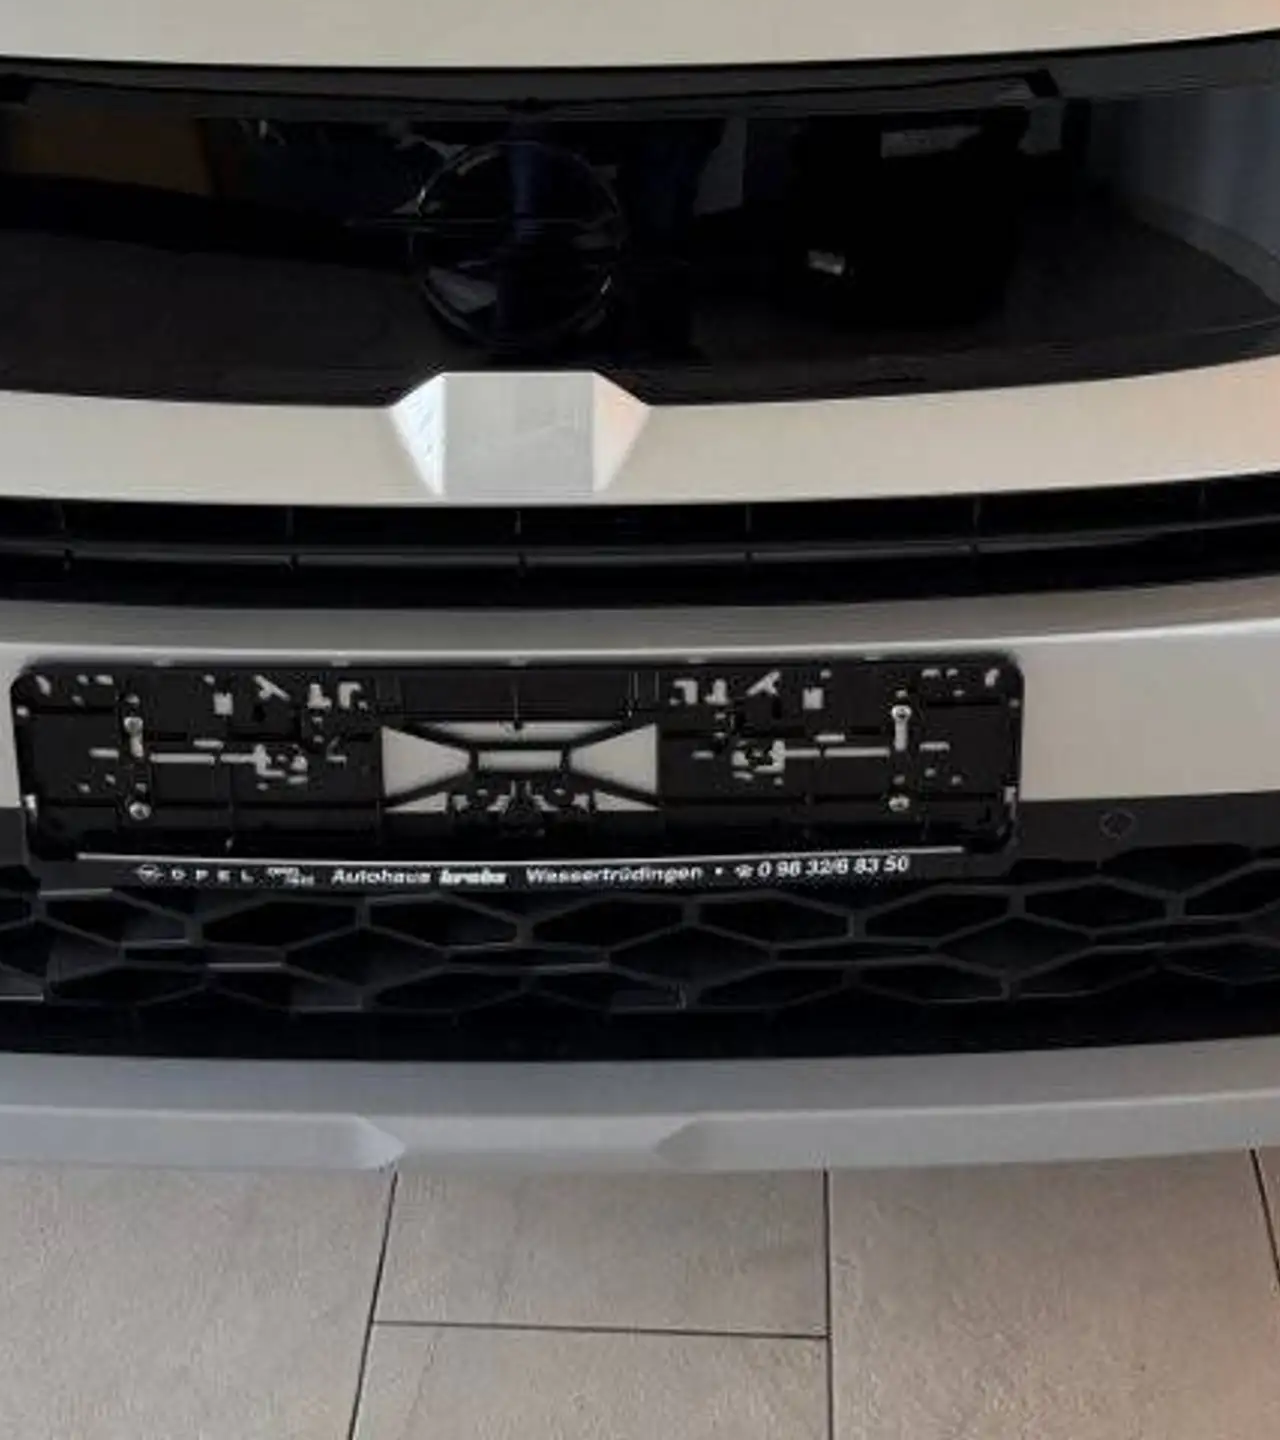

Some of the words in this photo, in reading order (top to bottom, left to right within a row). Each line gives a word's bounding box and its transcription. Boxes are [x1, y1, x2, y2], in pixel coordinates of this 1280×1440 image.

[171, 868, 255, 883] OPEL
[331, 867, 431, 885] Autohaus
[525, 866, 704, 885] Wassertrüdingen
[883, 854, 910, 873] 50
